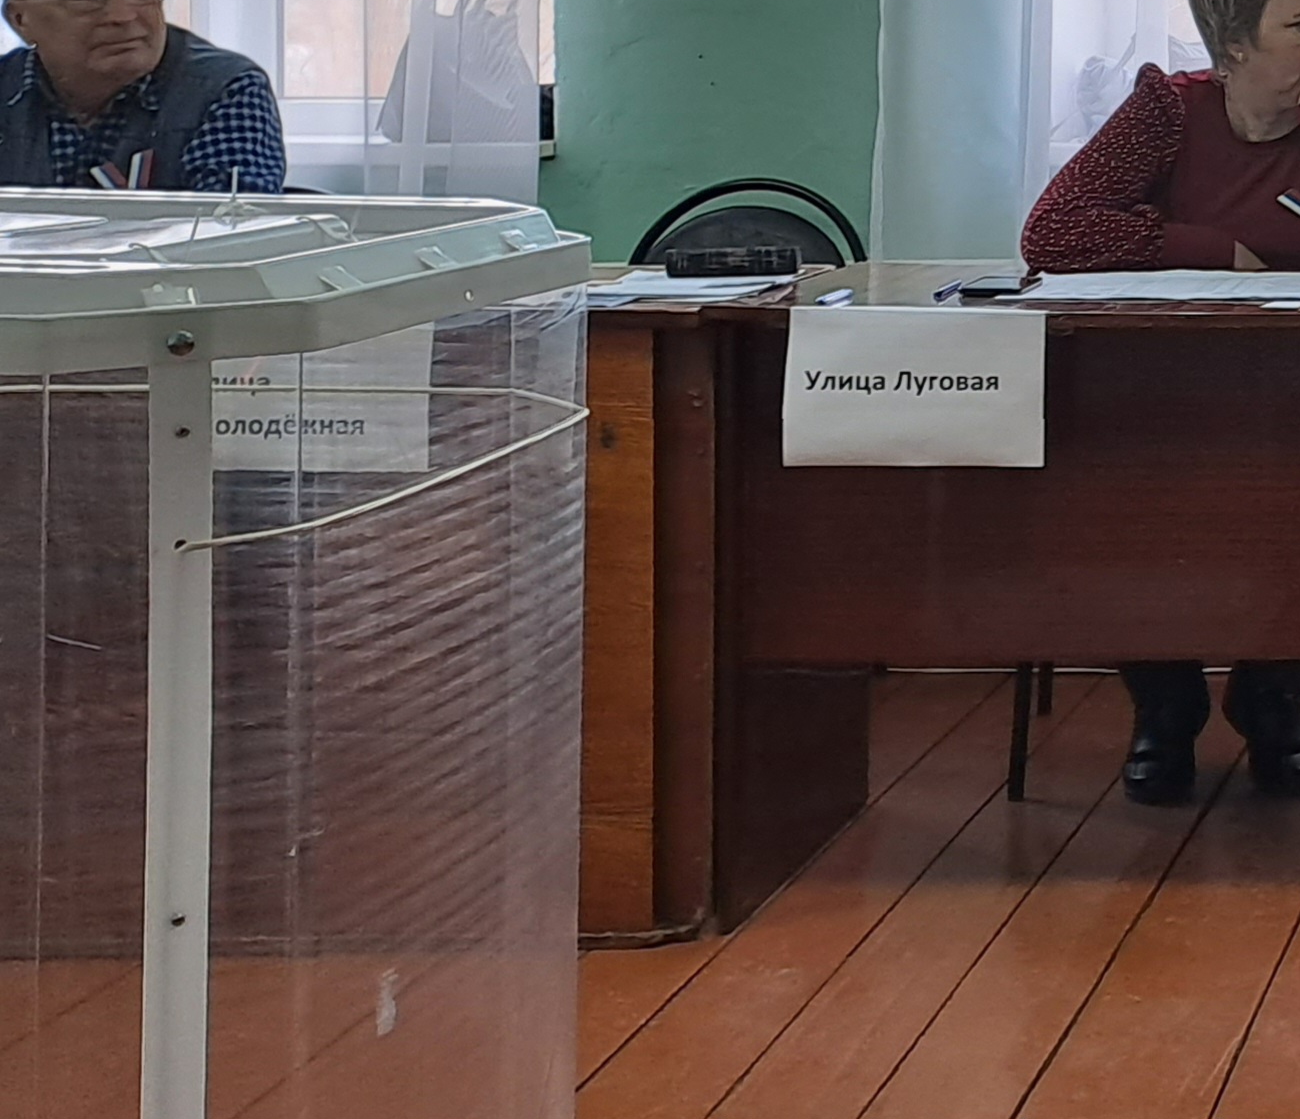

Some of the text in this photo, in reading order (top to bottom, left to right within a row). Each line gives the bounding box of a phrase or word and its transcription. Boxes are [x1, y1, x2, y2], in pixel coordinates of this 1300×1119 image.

[805, 370, 999, 396] Улица Луговая
[215, 413, 366, 440] олодёжная
